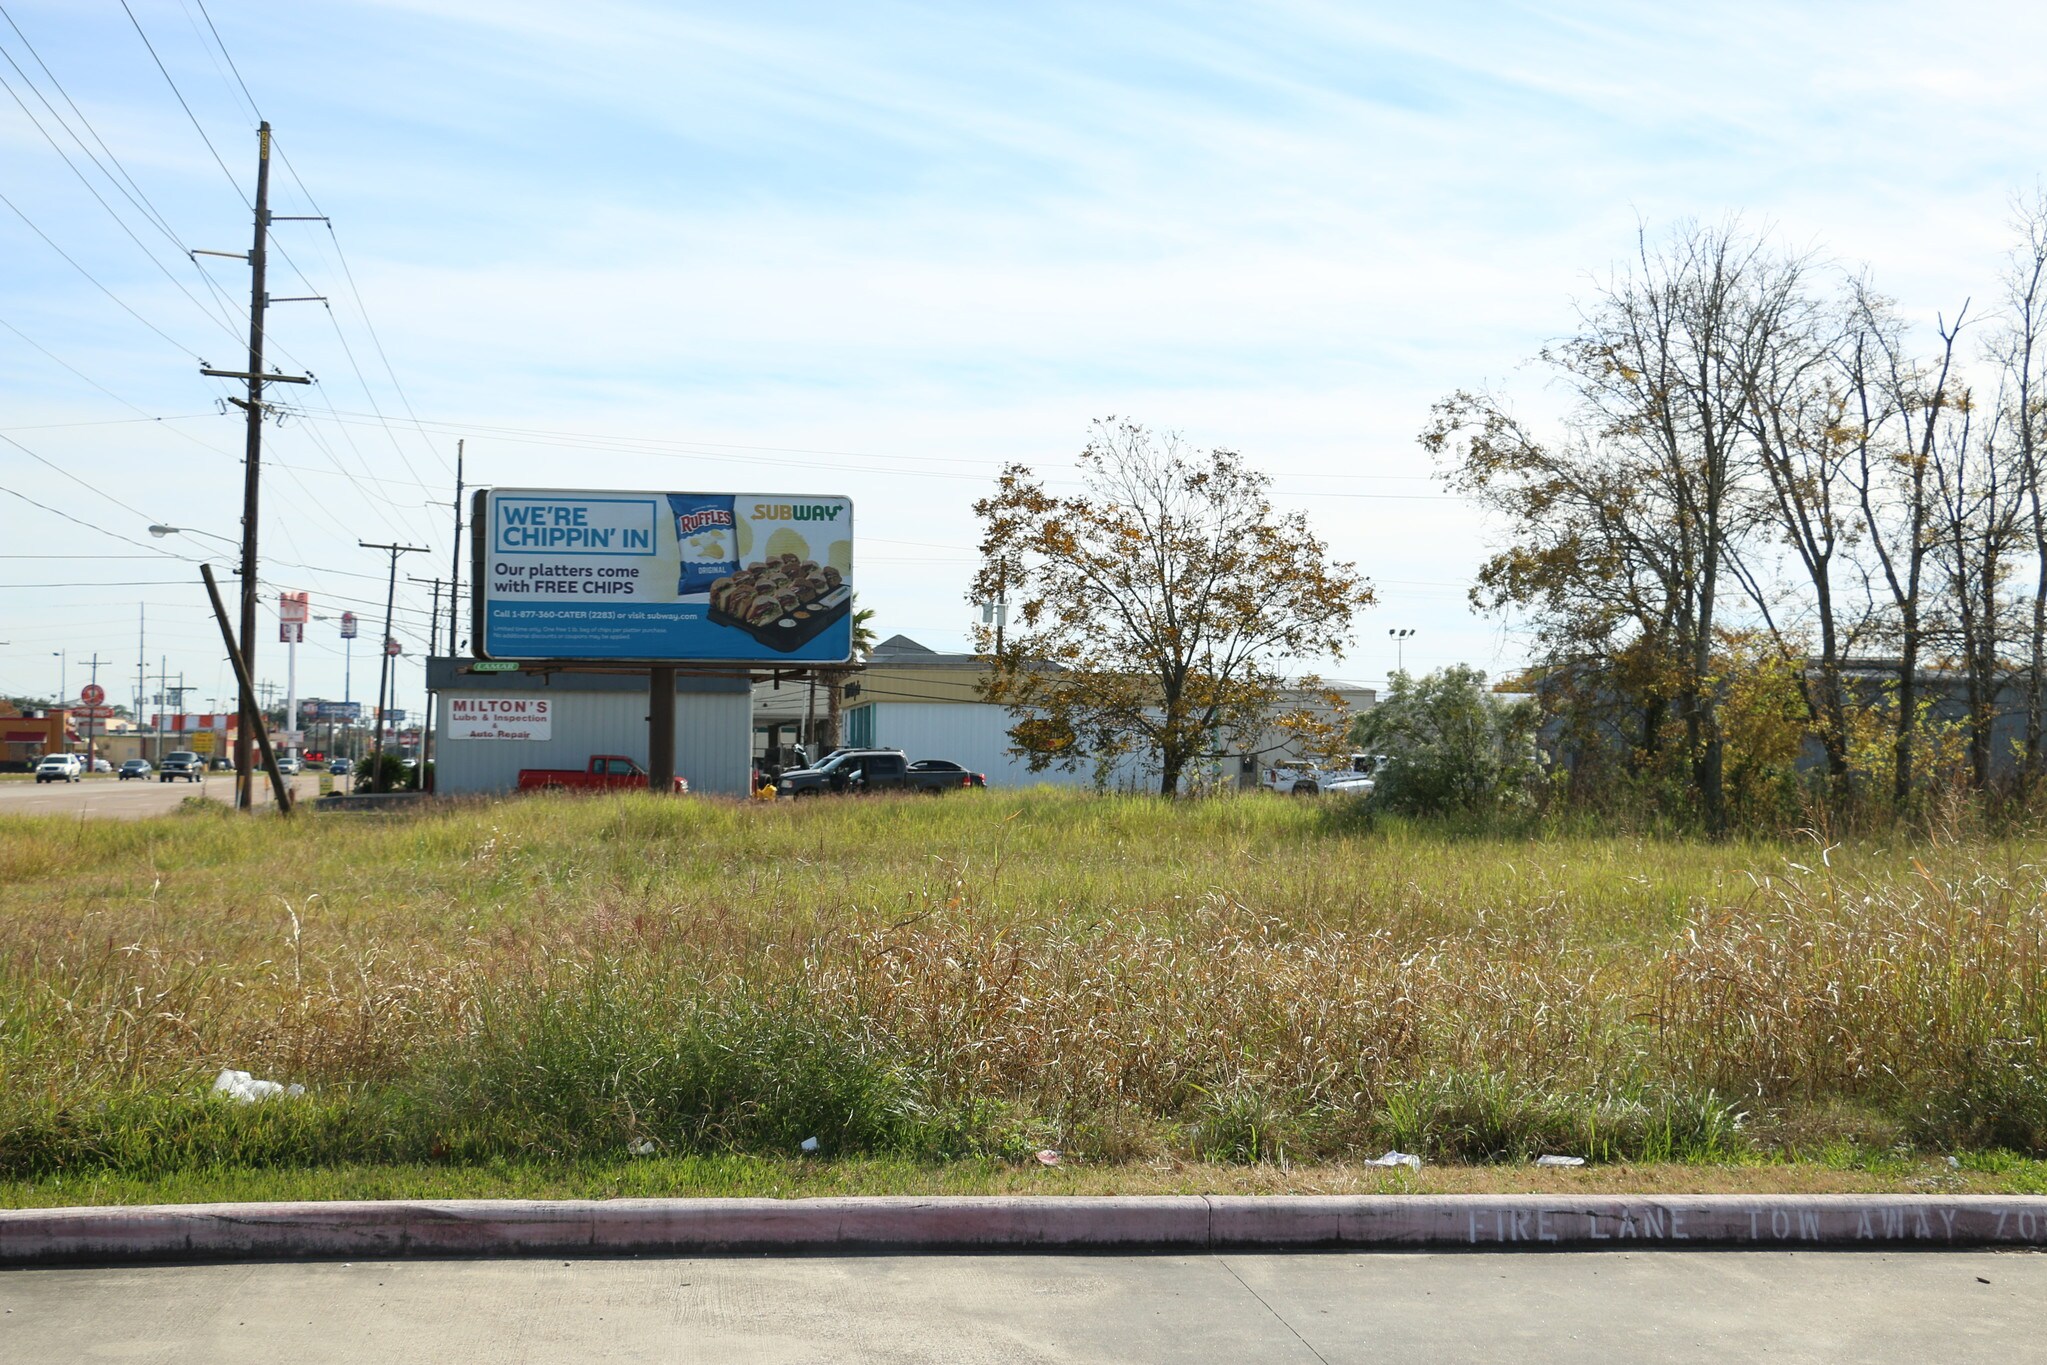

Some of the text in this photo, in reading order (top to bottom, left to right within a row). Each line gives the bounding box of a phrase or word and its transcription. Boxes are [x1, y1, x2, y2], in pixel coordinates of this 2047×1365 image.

[504, 506, 588, 526] WE'RE
[751, 504, 843, 521] SUBWAY
[680, 510, 732, 533] RUFFLES
[503, 527, 648, 548] CHIPPIN' IN
[495, 563, 639, 579] Our platters come
[698, 566, 727, 574] ORIGINAL
[495, 580, 634, 594] with FREE CHIPS
[493, 610, 510, 618] Call
[512, 610, 587, 619] 1-877-360-CATER
[588, 610, 616, 619] (2283)
[628, 611, 645, 619] visit
[646, 612, 698, 621] subway.com
[453, 700, 548, 713] MILTON'S
[494, 714, 547, 722] Inspection
[469, 730, 531, 739] Auto Repair
[1469, 1207, 2047, 1243] FIRE LANE TOW AWAY ZO
